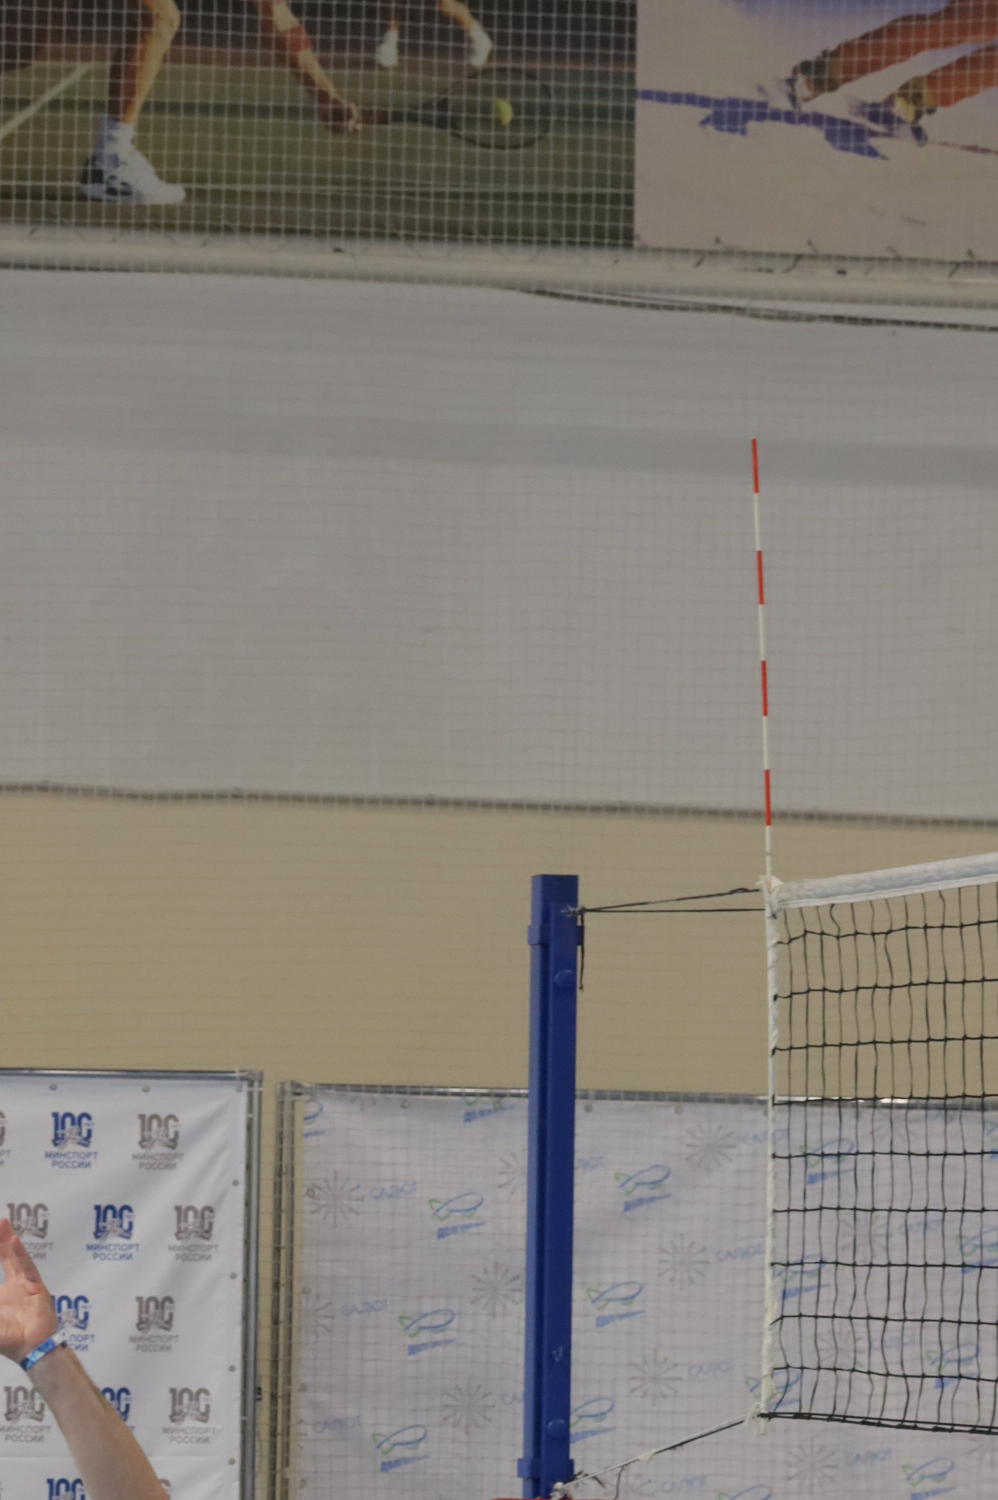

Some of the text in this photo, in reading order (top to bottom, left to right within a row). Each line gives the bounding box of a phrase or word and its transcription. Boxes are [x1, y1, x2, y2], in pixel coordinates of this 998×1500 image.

[45, 1151, 98, 1160] МИНСПОРТ
[52, 1160, 91, 1169] РОССИИ
[87, 1243, 139, 1252] МИНСПОРТ
[94, 1252, 132, 1261] РОССИИ
